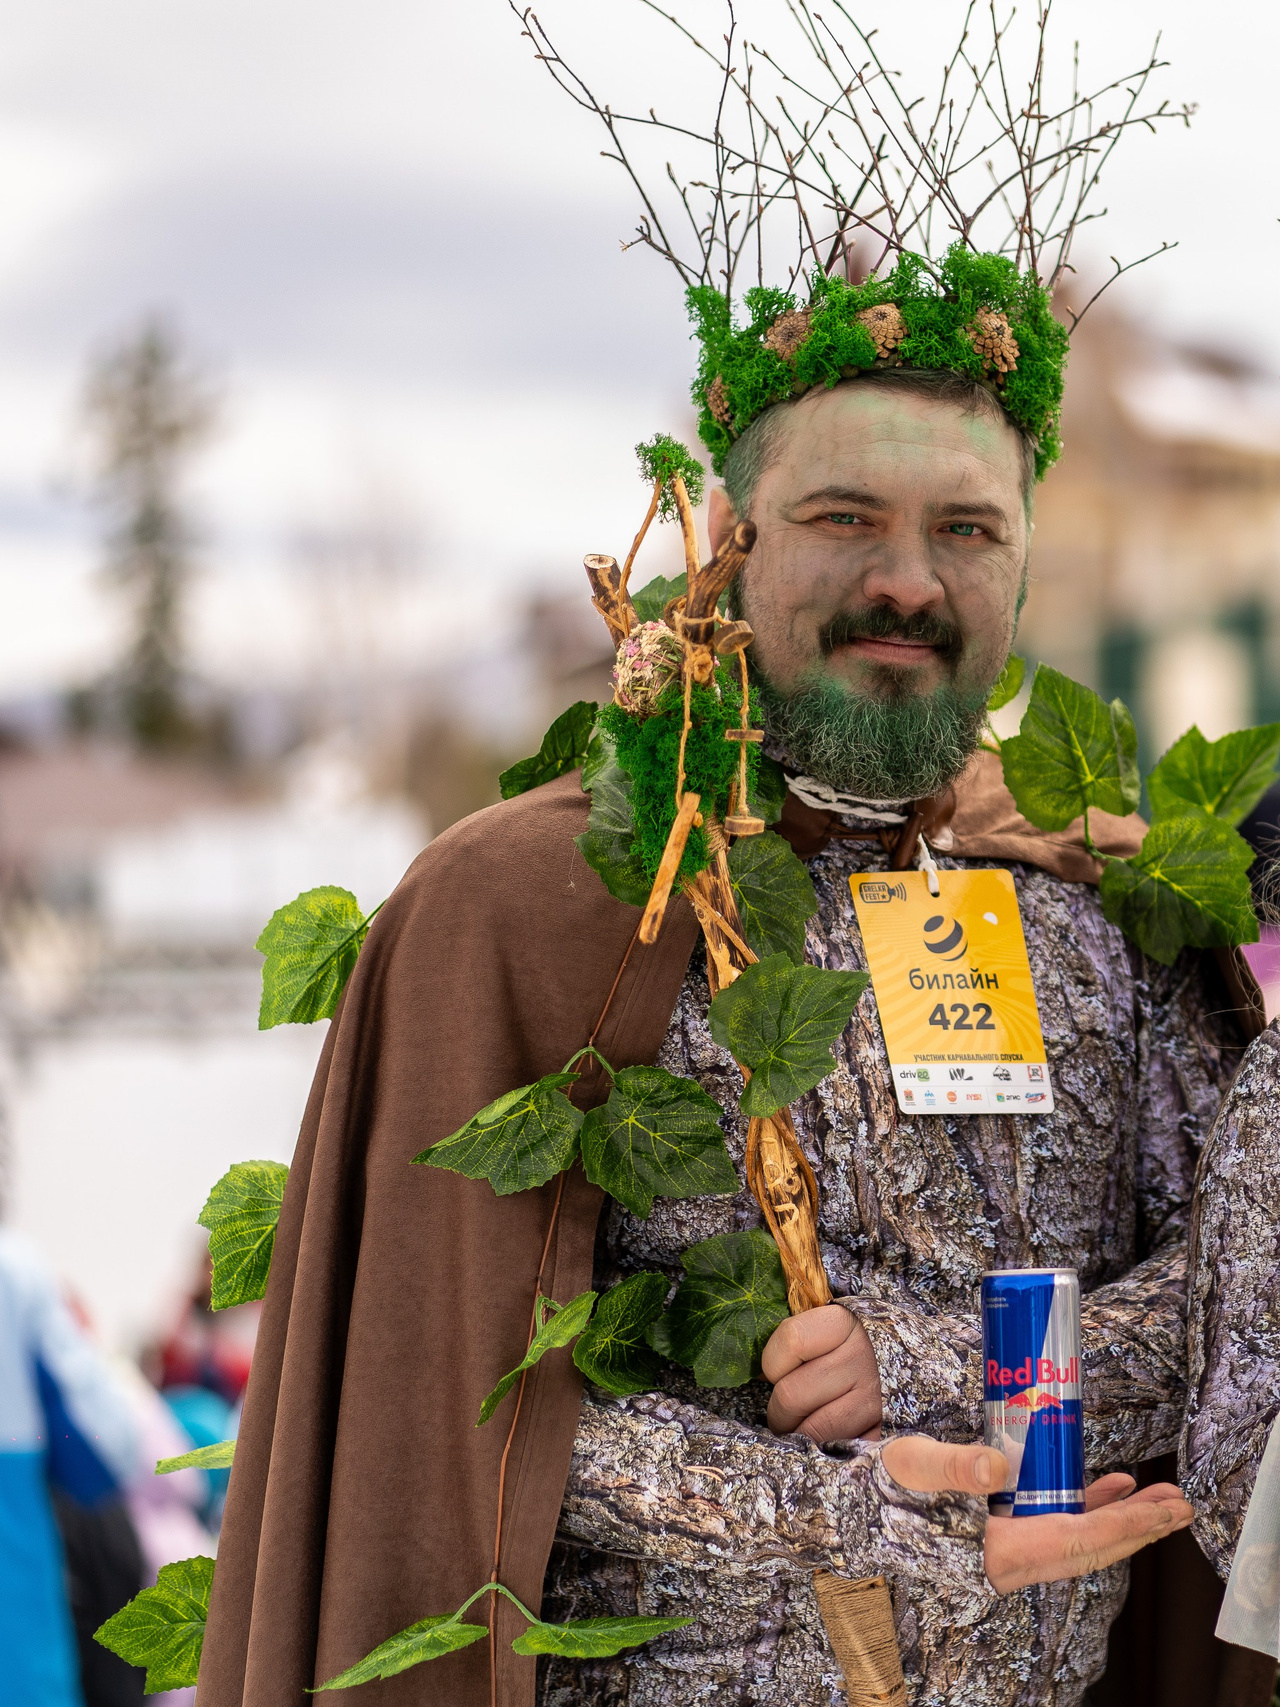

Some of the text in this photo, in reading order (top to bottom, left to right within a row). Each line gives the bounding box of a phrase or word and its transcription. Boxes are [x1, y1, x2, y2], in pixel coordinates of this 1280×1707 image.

[908, 968, 999, 990] билайн
[928, 1002, 996, 1030] 422
[914, 1053, 1024, 1063] УЧАСТНИК КАРНАВАЛЬНОГО СПУСКА
[987, 1356, 1078, 1386] Red Bull
[990, 1413, 1076, 1426] ENERGY DRINK
